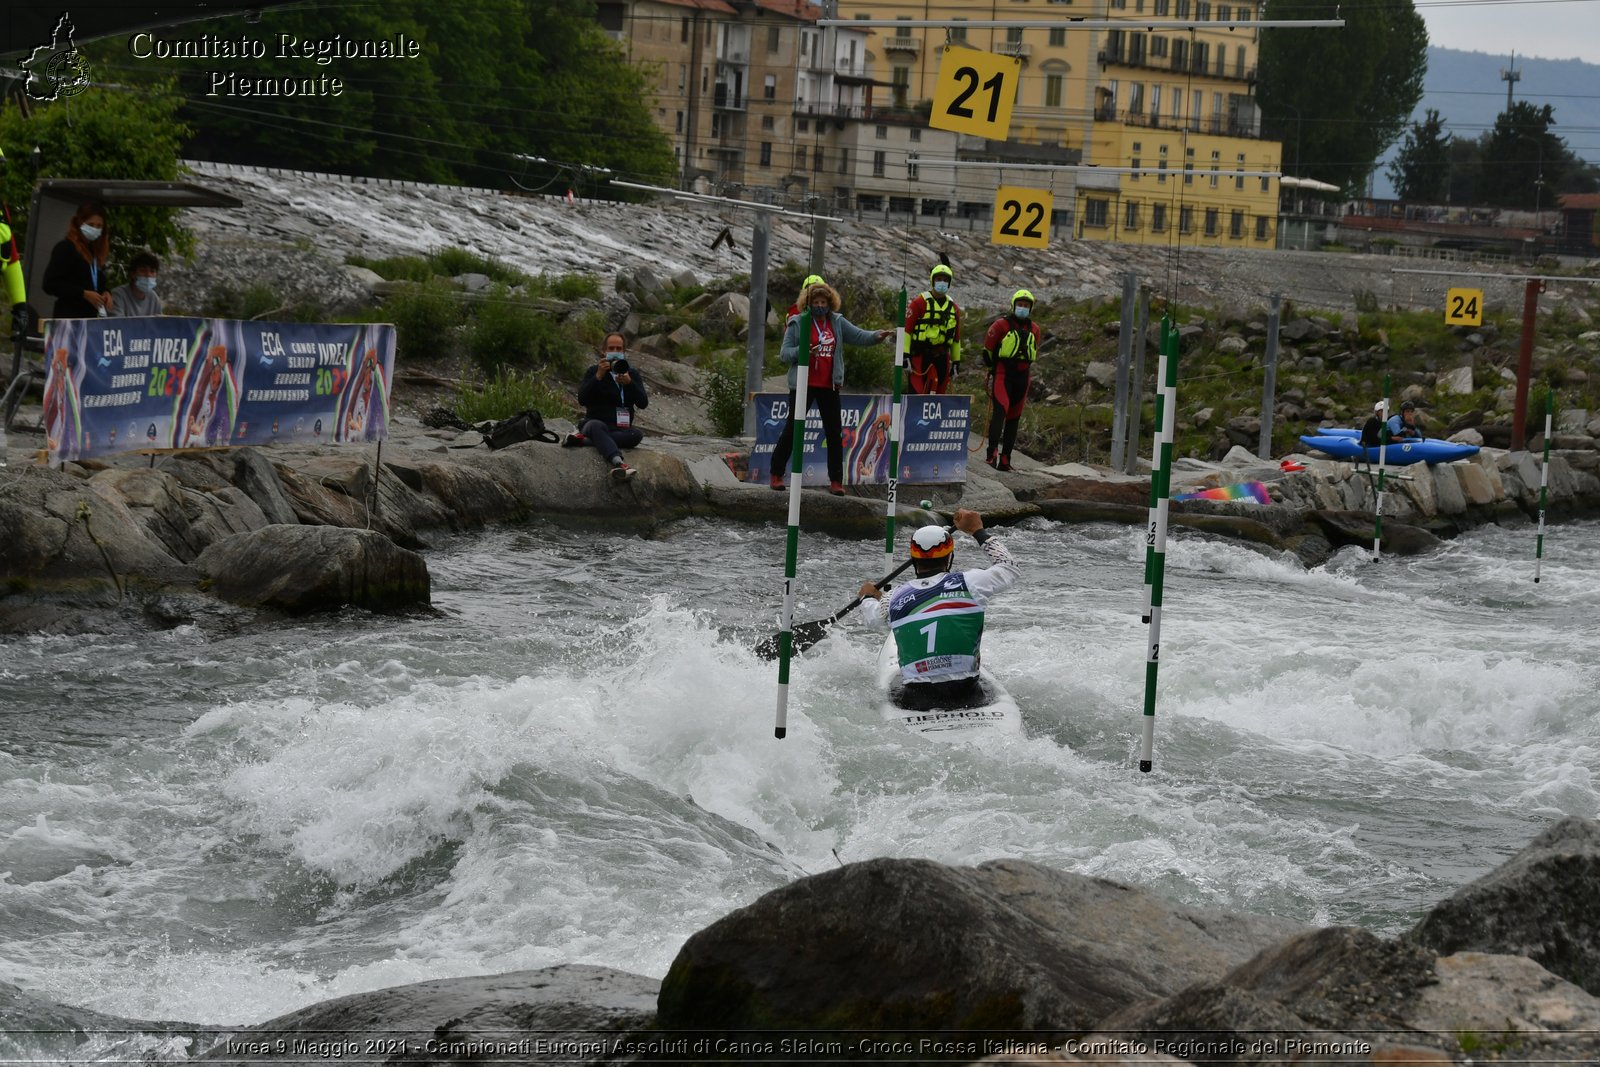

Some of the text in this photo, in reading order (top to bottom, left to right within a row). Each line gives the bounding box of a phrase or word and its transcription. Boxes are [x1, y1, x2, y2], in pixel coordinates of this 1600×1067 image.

[946, 66, 1004, 123] 21
[1000, 200, 1045, 239] 22
[1451, 295, 1478, 319] 24
[103, 329, 124, 357] ECA
[152, 337, 188, 364] IVREA
[260, 331, 286, 356] ECA
[291, 342, 316, 354] CANOE
[287, 356, 316, 369] SLALOM
[274, 373, 311, 385] EUROPEAN
[247, 390, 309, 402] CHAMPIONSHIPS
[840, 409, 860, 427] REA
[922, 402, 942, 420] ECA
[948, 409, 969, 418] CANOE
[940, 419, 967, 428] SLALOM
[928, 431, 965, 440] EUROPEAN
[906, 442, 962, 452] CHAMPIONSHIPS
[919, 620, 938, 654] 1
